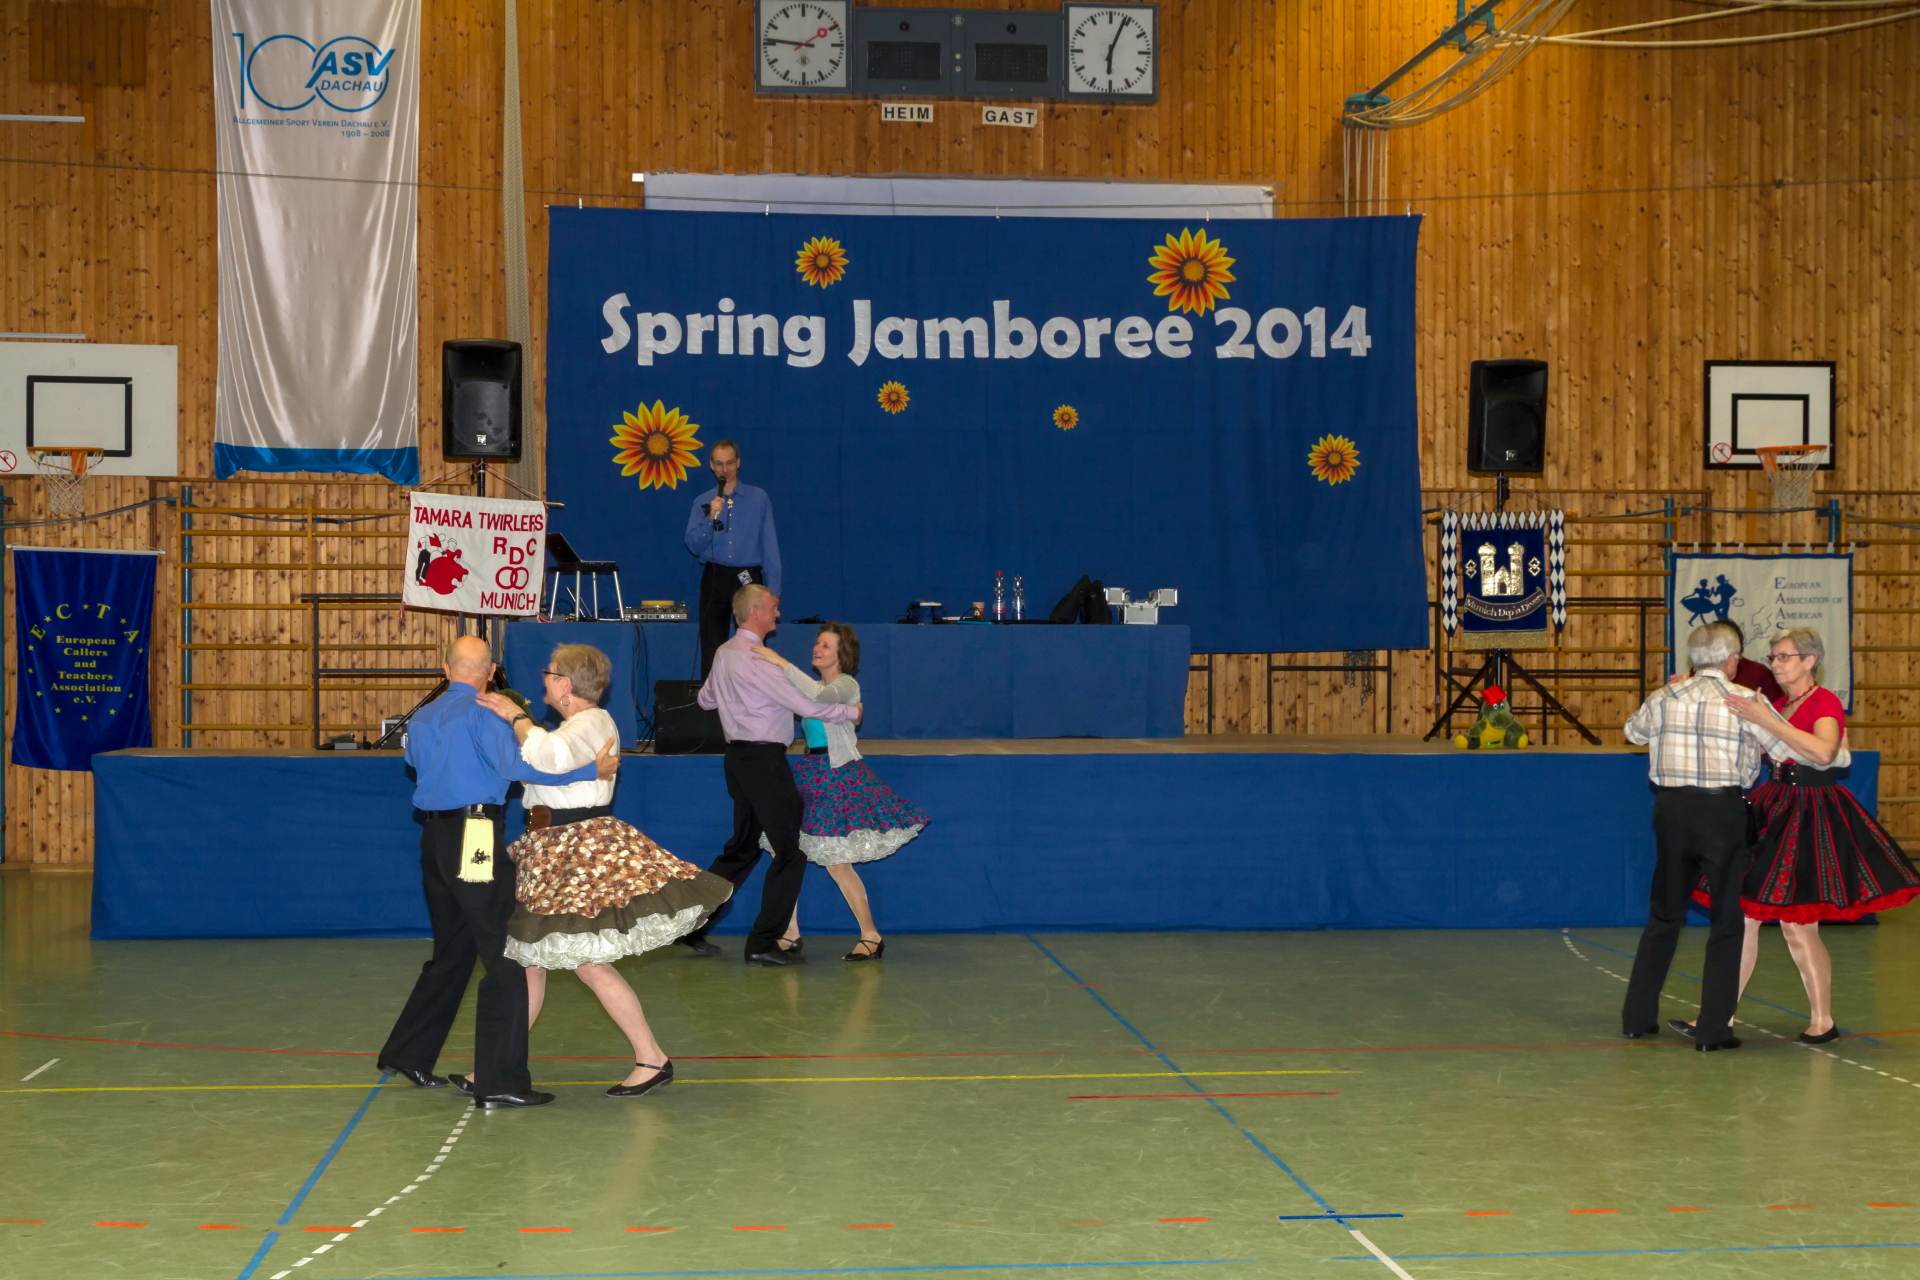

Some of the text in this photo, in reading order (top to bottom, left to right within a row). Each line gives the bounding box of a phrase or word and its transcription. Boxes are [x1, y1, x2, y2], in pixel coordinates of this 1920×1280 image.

[304, 48, 397, 89] ASV
[320, 79, 384, 92] DACHAU
[883, 106, 930, 120] HEIM
[984, 110, 1035, 125] GAST
[232, 115, 284, 126] ALLGEMEINER
[286, 117, 310, 127] SPORT
[312, 118, 339, 128] VEREIN
[341, 119, 373, 128] DACHAU
[341, 129, 362, 138] 1908
[370, 130, 390, 138] 2008
[600, 292, 1372, 368] Spring Jamboree 2014
[413, 506, 473, 529] TAMARA
[1774, 576, 1822, 590] EUROPEAN
[480, 590, 537, 611] MUNICH
[1775, 592, 1844, 605] ASSOCIATION OF
[1465, 598, 1497, 617] Munich
[1776, 607, 1823, 620] AMERICAN
[55, 635, 116, 646] European
[63, 647, 108, 657] Callers
[73, 660, 97, 668] and
[57, 670, 114, 681] Teachers
[50, 682, 122, 693] Association
[73, 695, 97, 704] e.V.
